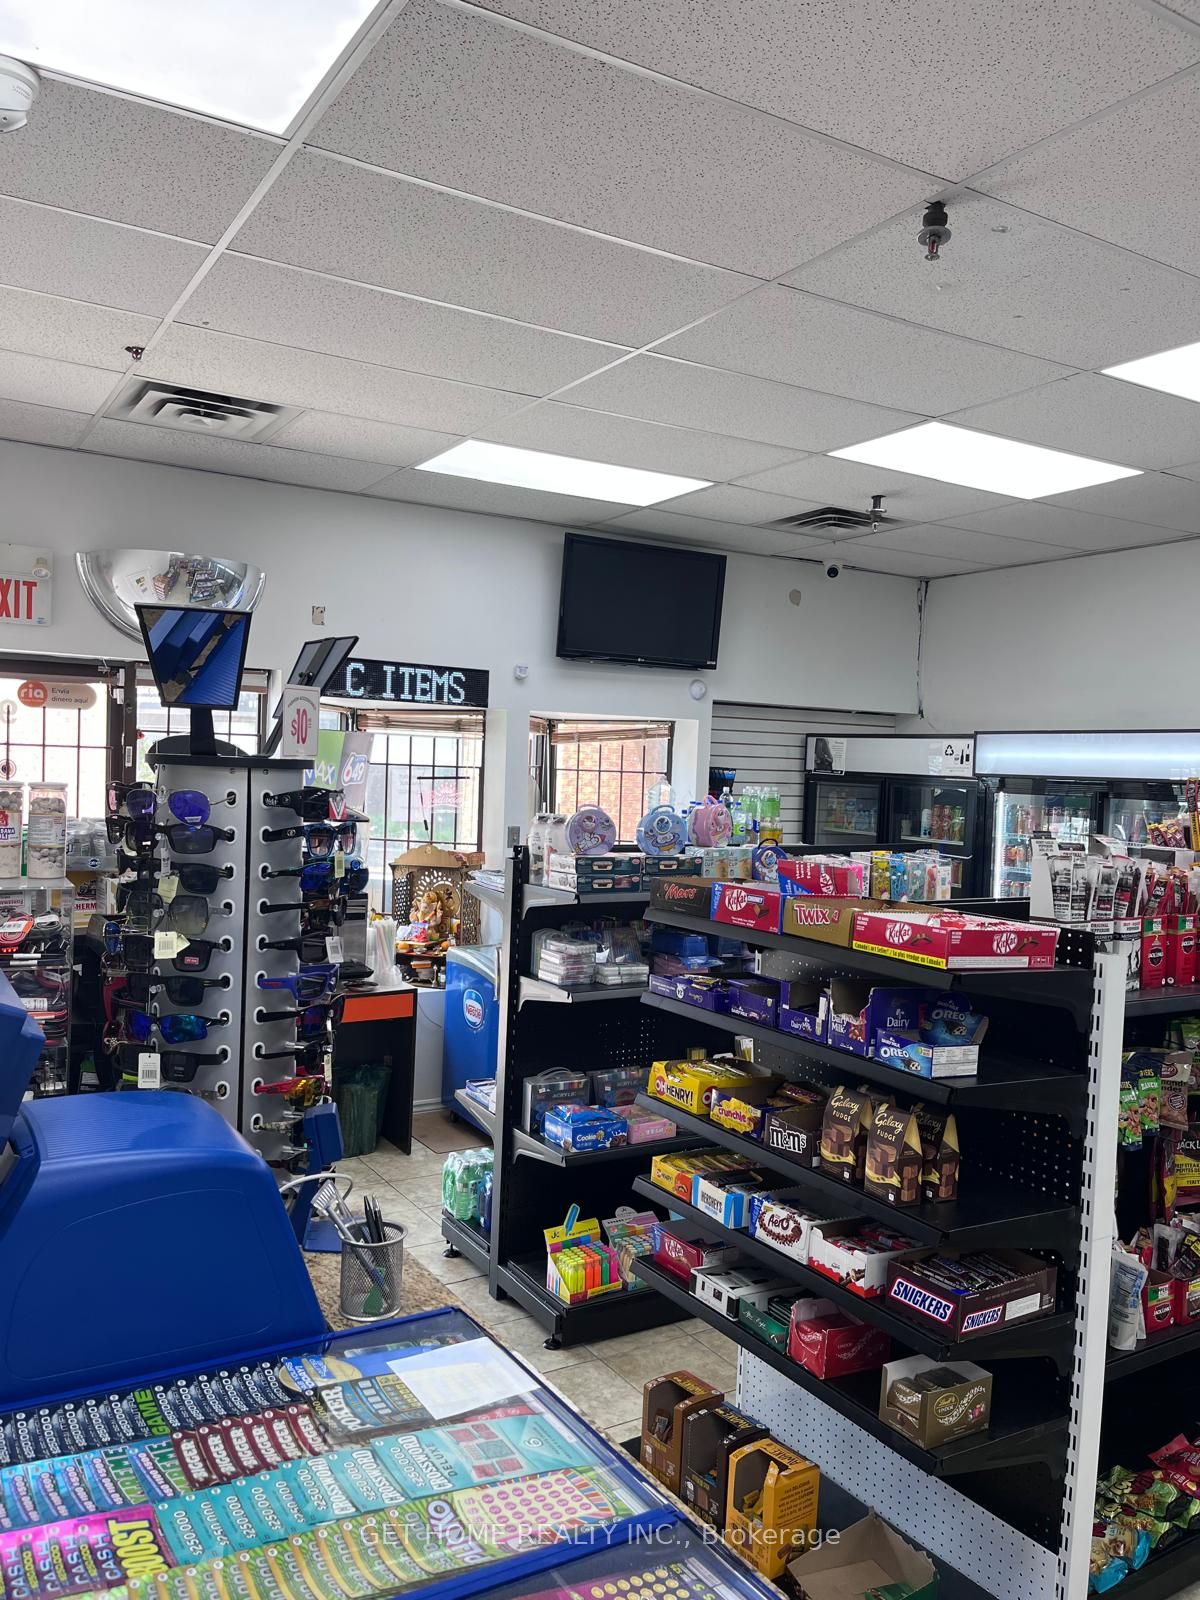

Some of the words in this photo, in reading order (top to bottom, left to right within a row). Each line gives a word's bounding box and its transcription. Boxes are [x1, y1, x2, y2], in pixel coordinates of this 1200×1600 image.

[20, 683, 44, 698] ria
[382, 665, 466, 704] ITEMS
[664, 883, 697, 900] Mars
[725, 889, 748, 911] KitKat
[793, 903, 831, 925] Twix
[887, 922, 912, 943] KitKat
[993, 932, 1018, 953] KitKat
[886, 1016, 910, 1028] Dairy
[932, 1009, 966, 1021] OREO
[880, 1046, 910, 1058] OREO
[655, 1080, 666, 1092] OH
[666, 1084, 694, 1107] HENRY!
[830, 1095, 860, 1115] Galaxy
[718, 1106, 747, 1123] crunchie
[832, 1111, 852, 1123] FUDGE
[874, 1112, 905, 1134] Galaxy
[876, 1129, 897, 1142] FUDGE
[1177, 1139, 1196, 1150] JACK
[768, 1215, 790, 1231] Aero
[892, 1280, 952, 1321] SNICKERS
[963, 1307, 1002, 1331] SNICKERS
[133, 1389, 171, 1437] GAME
[321, 1386, 369, 1432] POKER
[230, 1426, 259, 1469] BIGGER
[251, 1424, 281, 1466] BIGGER
[273, 1418, 302, 1458] BIGGER
[297, 1414, 329, 1454] BIGGER
[180, 1438, 209, 1482] BIGGER
[207, 1433, 237, 1476] BIGGER
[390, 1446, 426, 1488] $250,000
[397, 1434, 453, 1491] CROSSWORD
[425, 1442, 458, 1478] DELUXE
[297, 1468, 328, 1512] $250,000
[307, 1457, 357, 1516] CROSSWORD
[343, 1460, 377, 1502] $250,000
[351, 1449, 406, 1505] CROSSWORD
[226, 1495, 256, 1540] $250,000
[251, 1486, 281, 1531] $250,000
[275, 1480, 305, 1524] $250,000
[108, 1519, 169, 1579] BOOST
[174, 1510, 204, 1556] $250,000
[6, 1546, 30, 1599] CASH
[35, 1540, 60, 1592] CASH
[63, 1534, 89, 1586] CASH
[92, 1532, 122, 1581] CASH
